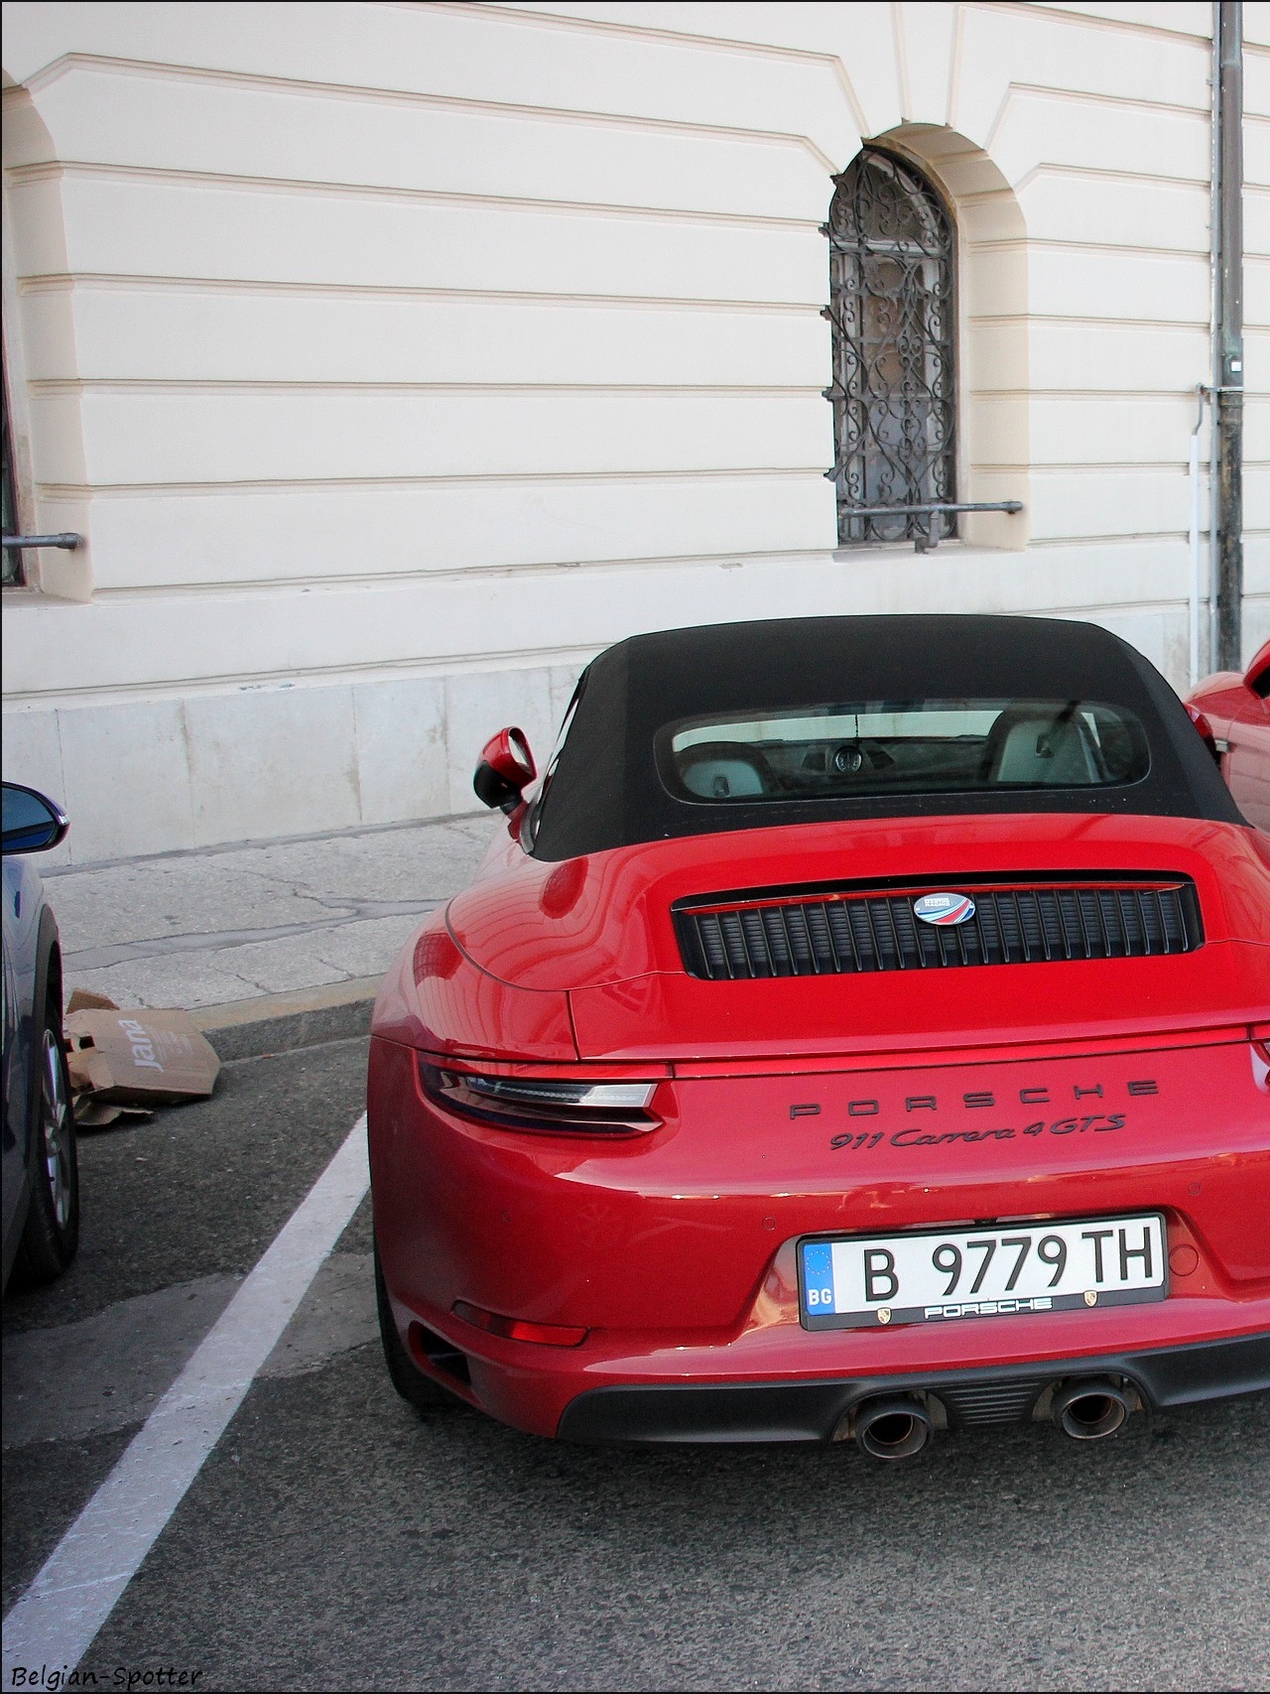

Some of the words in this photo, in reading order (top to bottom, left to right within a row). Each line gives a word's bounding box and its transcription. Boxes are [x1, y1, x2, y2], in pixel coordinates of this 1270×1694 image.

[790, 1080, 1159, 1120] PORSCHE
[830, 1132, 884, 1151] 911
[890, 1129, 1016, 1148] Carrera
[1023, 1121, 1042, 1137] 4
[1050, 1113, 1126, 1135] GTS
[863, 1248, 899, 1302] B
[932, 1234, 1068, 1297] 9779
[1081, 1226, 1153, 1284] TH
[808, 1289, 832, 1305] BG
[924, 1298, 1053, 1320] PORSCHE
